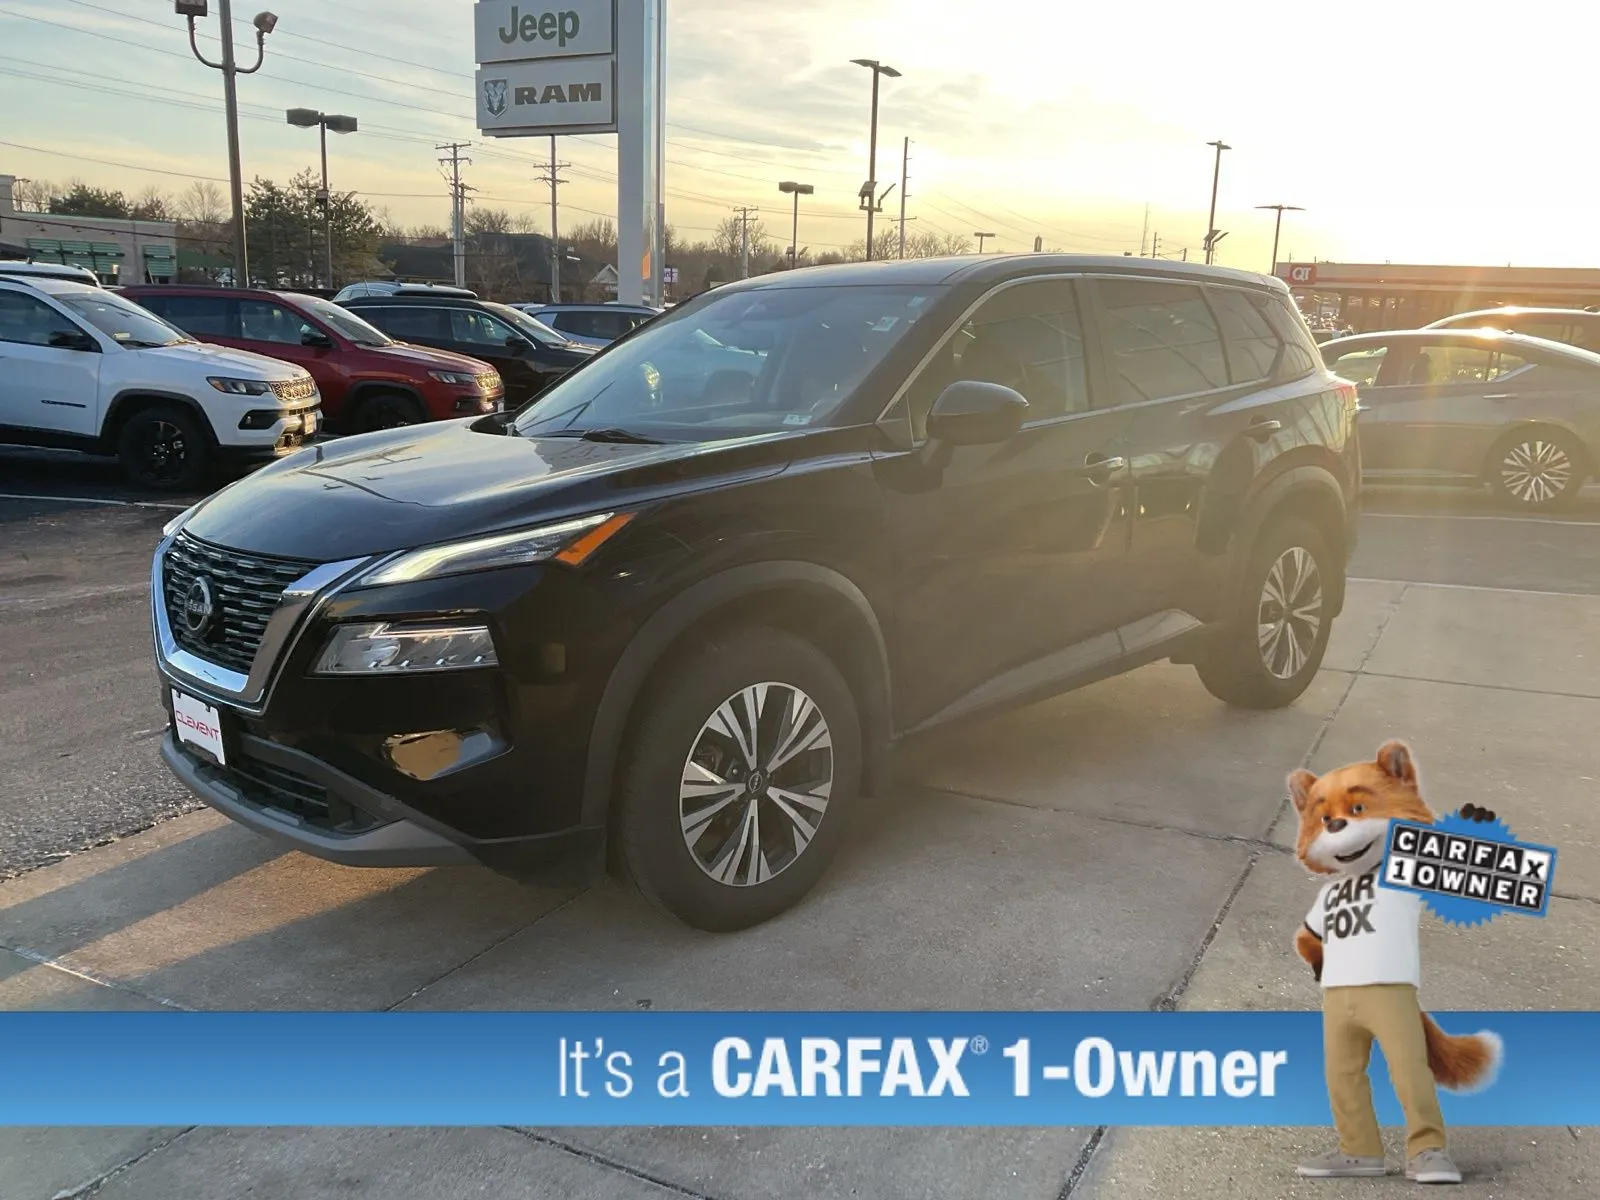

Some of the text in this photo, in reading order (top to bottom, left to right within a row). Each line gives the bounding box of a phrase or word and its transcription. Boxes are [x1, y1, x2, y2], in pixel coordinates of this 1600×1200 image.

[498, 6, 580, 47] Jeep
[514, 83, 602, 106] RAM
[1292, 267, 1312, 282] QT
[175, 710, 220, 741] CLEMENT
